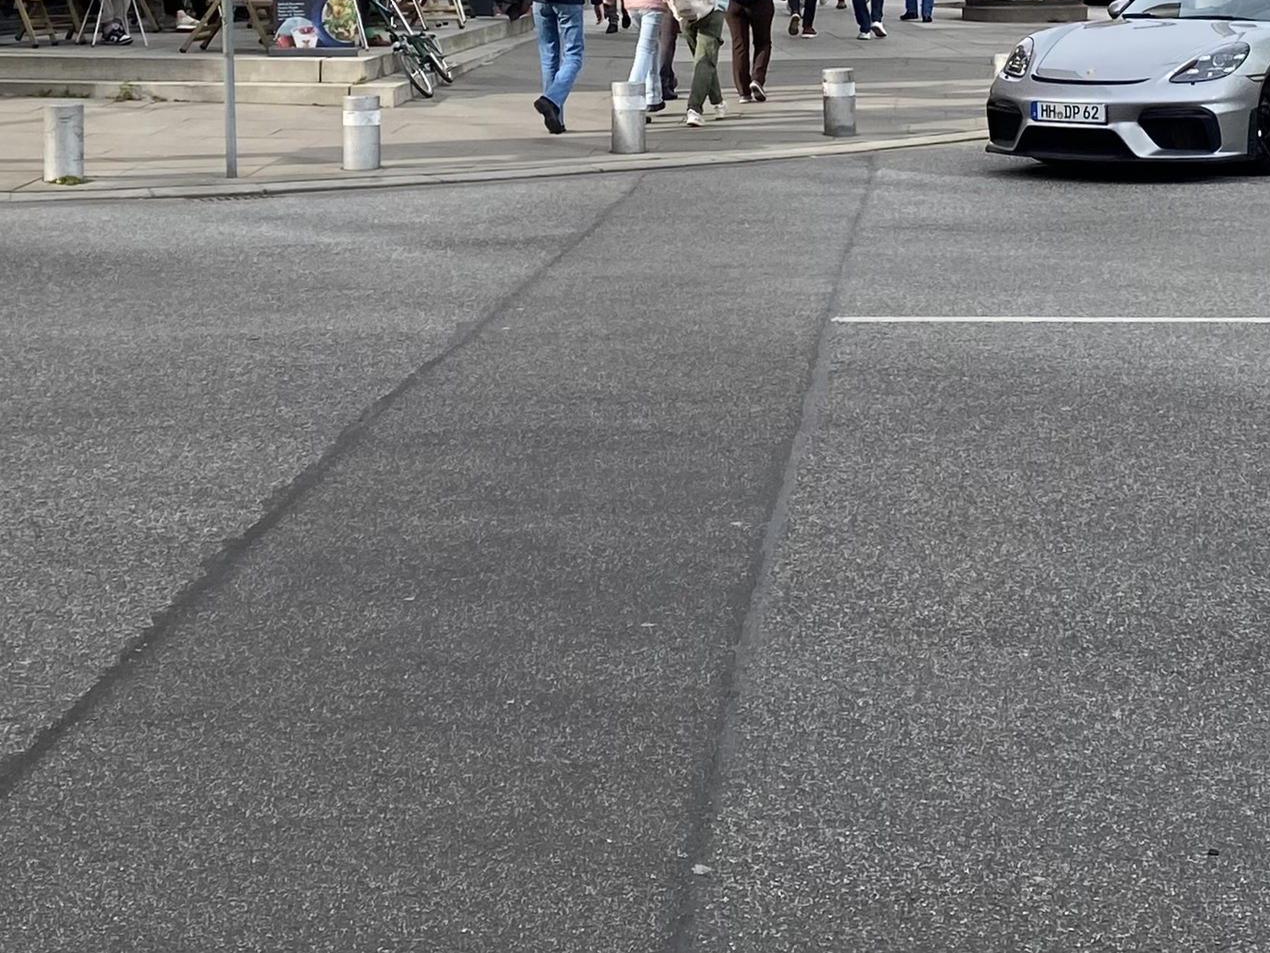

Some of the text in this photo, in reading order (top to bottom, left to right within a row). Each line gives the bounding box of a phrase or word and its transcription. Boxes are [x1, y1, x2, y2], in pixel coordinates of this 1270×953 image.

[1041, 104, 1099, 120] HH DP 62
